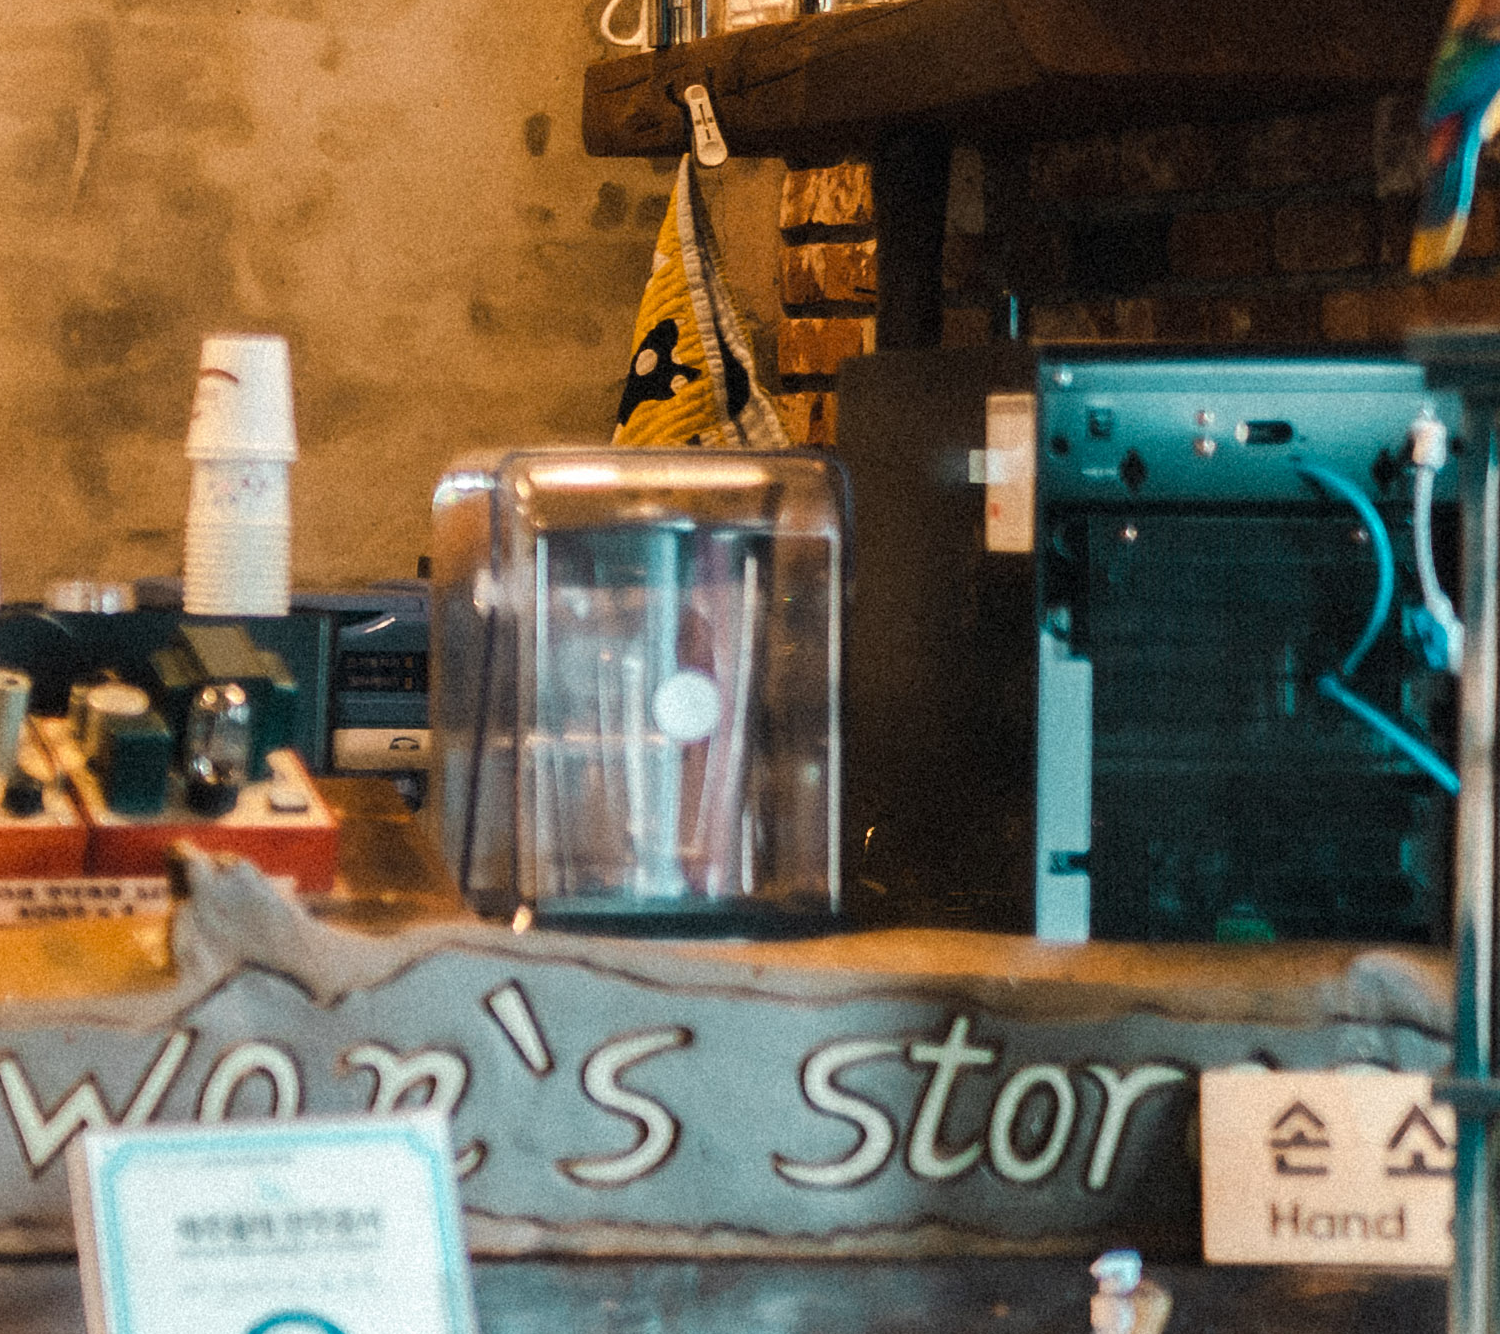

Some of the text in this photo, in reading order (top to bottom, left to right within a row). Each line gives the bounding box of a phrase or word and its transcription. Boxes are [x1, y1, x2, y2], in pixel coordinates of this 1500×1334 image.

[768, 1011, 1310, 1193] stor
[1269, 1099, 1330, 1176] 손
[1268, 1202, 1407, 1241] Hand
